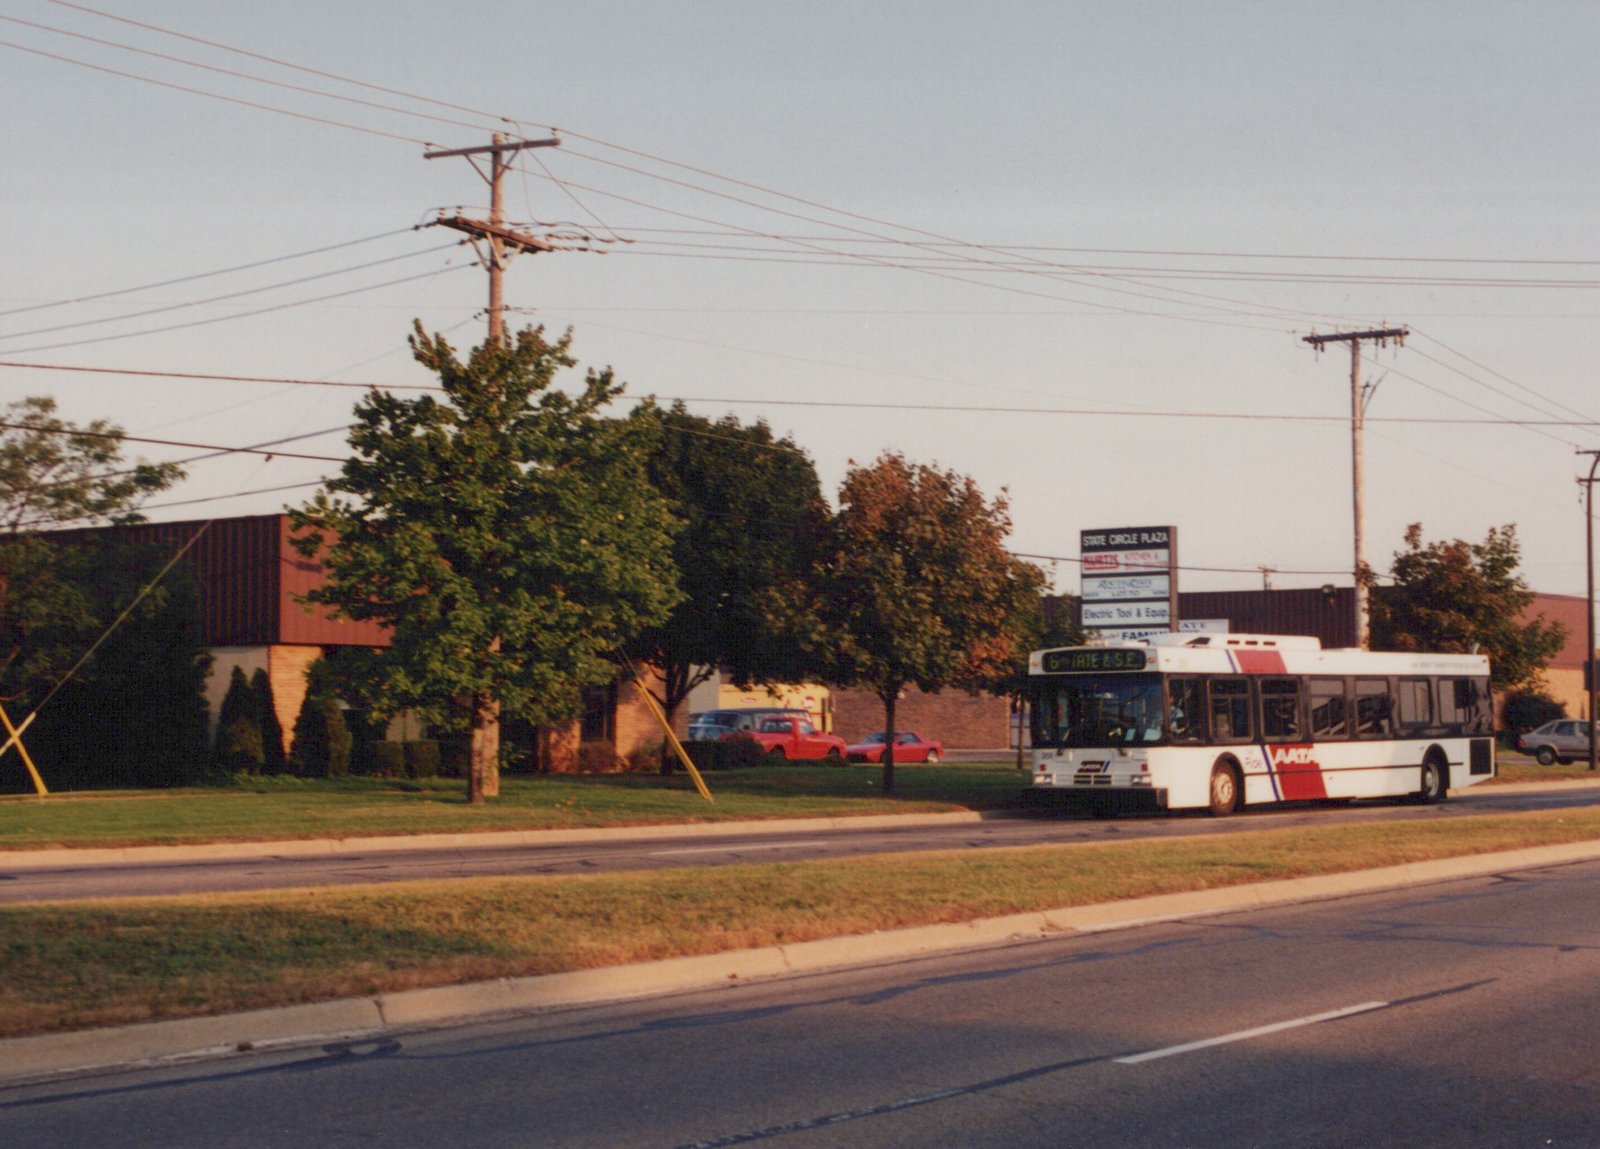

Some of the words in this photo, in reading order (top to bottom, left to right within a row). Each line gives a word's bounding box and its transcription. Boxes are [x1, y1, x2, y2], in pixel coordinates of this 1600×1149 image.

[1083, 534, 1107, 547] STATE
[1109, 533, 1138, 545] CIRCLE
[1141, 531, 1168, 544] PLAZA
[1084, 609, 1113, 620] Electric
[1116, 608, 1132, 618] Tool
[1275, 747, 1318, 764] AATA
